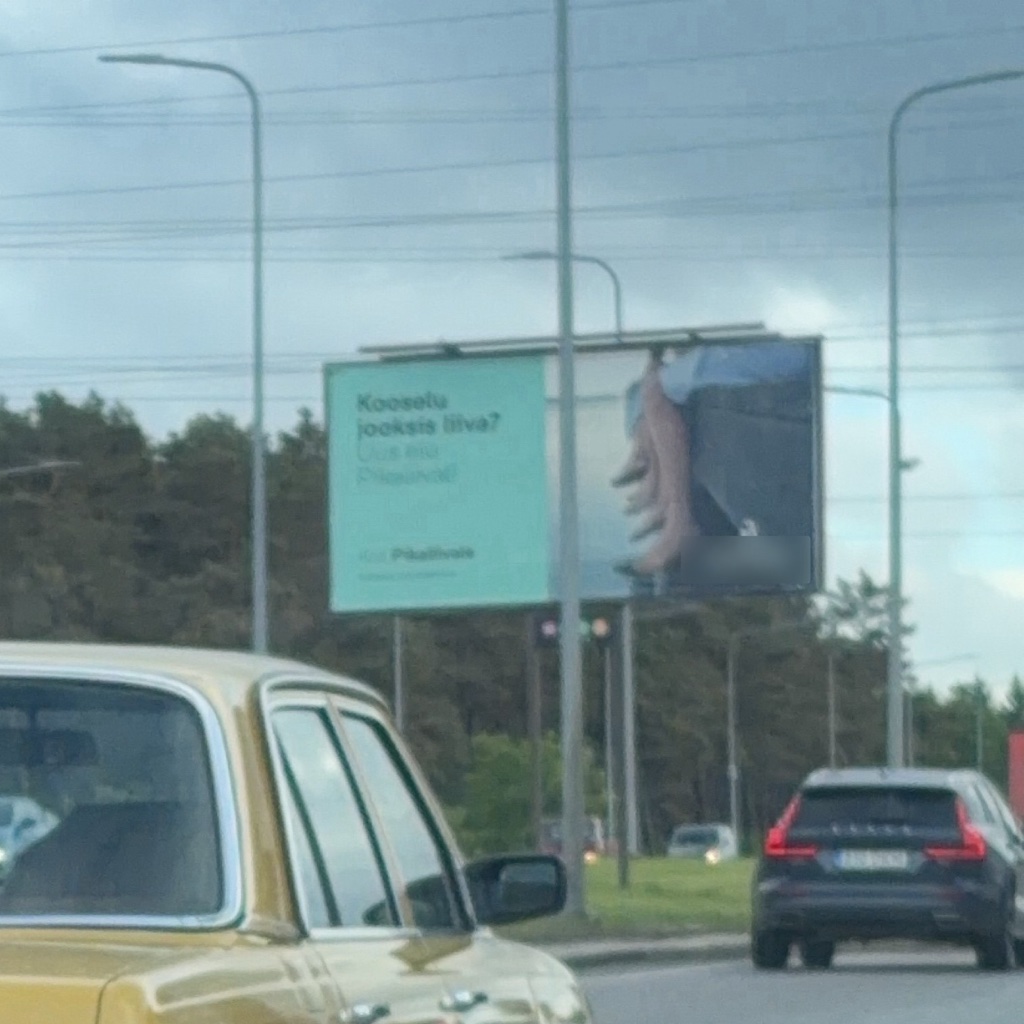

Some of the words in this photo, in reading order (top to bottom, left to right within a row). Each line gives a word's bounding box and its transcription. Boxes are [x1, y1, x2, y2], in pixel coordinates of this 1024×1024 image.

[357, 391, 448, 412] Kooselu
[357, 418, 437, 441] jooksis
[443, 411, 501, 434] liiva?
